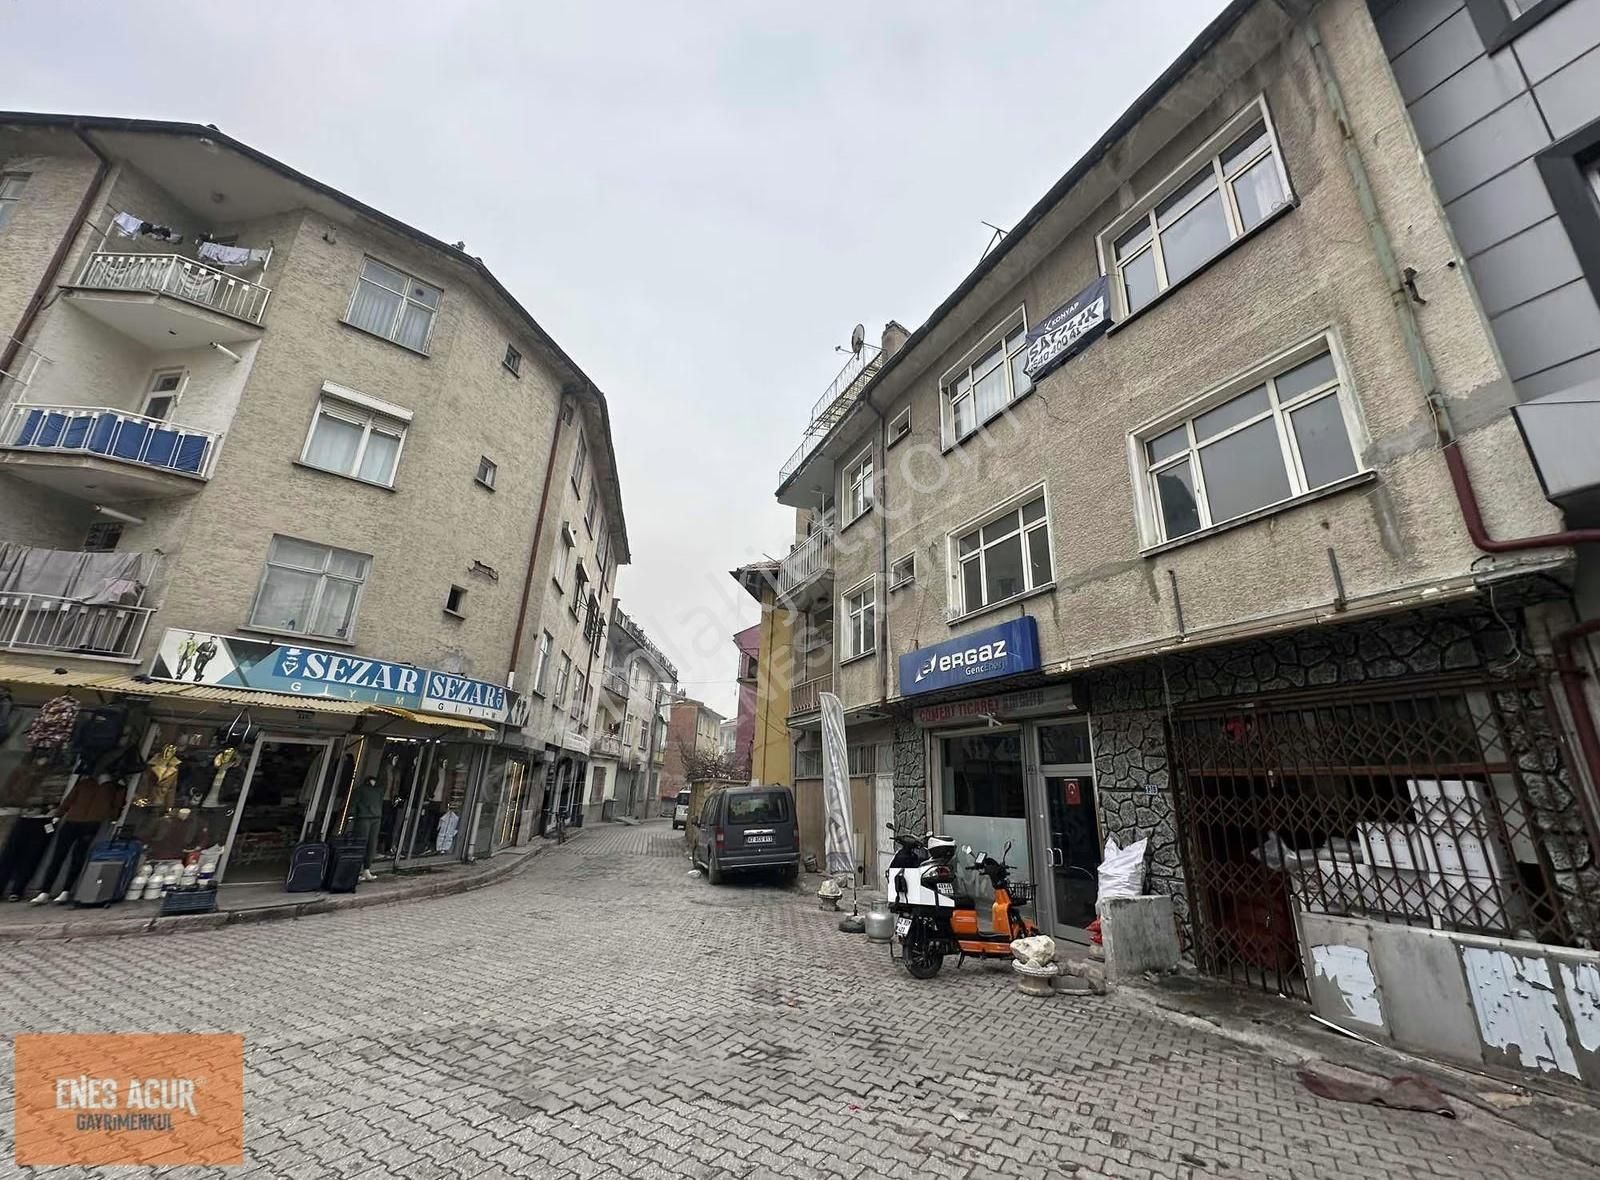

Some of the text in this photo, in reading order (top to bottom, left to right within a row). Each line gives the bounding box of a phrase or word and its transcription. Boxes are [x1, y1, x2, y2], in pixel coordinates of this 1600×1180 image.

[1029, 303, 1099, 361] SATILIK
[302, 652, 418, 694] SEZAR
[431, 675, 496, 707] SEZAR
